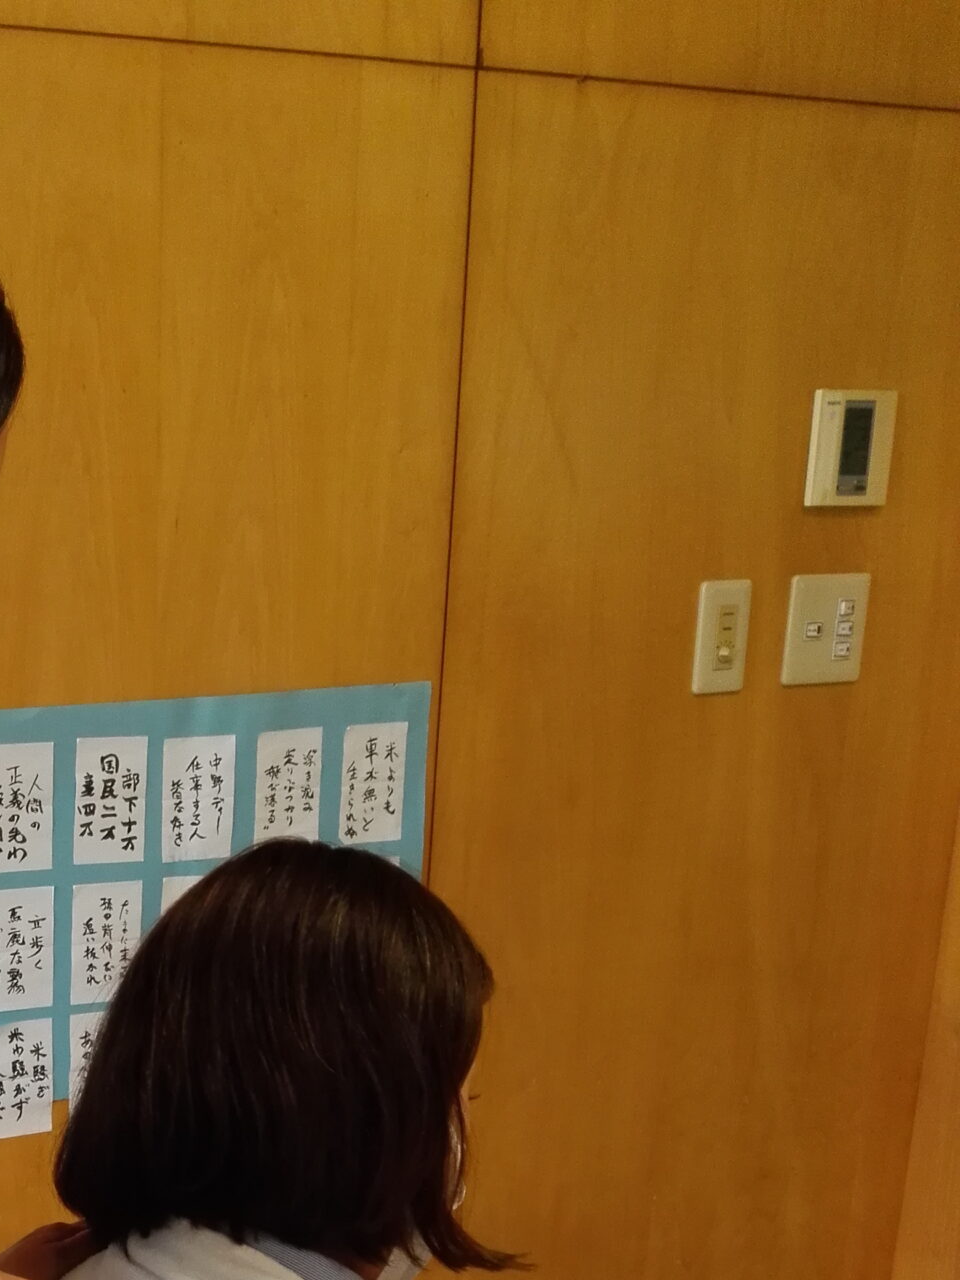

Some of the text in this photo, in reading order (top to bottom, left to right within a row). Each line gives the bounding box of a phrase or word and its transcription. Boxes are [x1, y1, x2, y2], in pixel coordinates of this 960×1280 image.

[26, 773, 44, 831] 人間の
[100, 753, 119, 841] 国民二万
[121, 768, 140, 852] 部下十万
[383, 742, 399, 815] 米よりも
